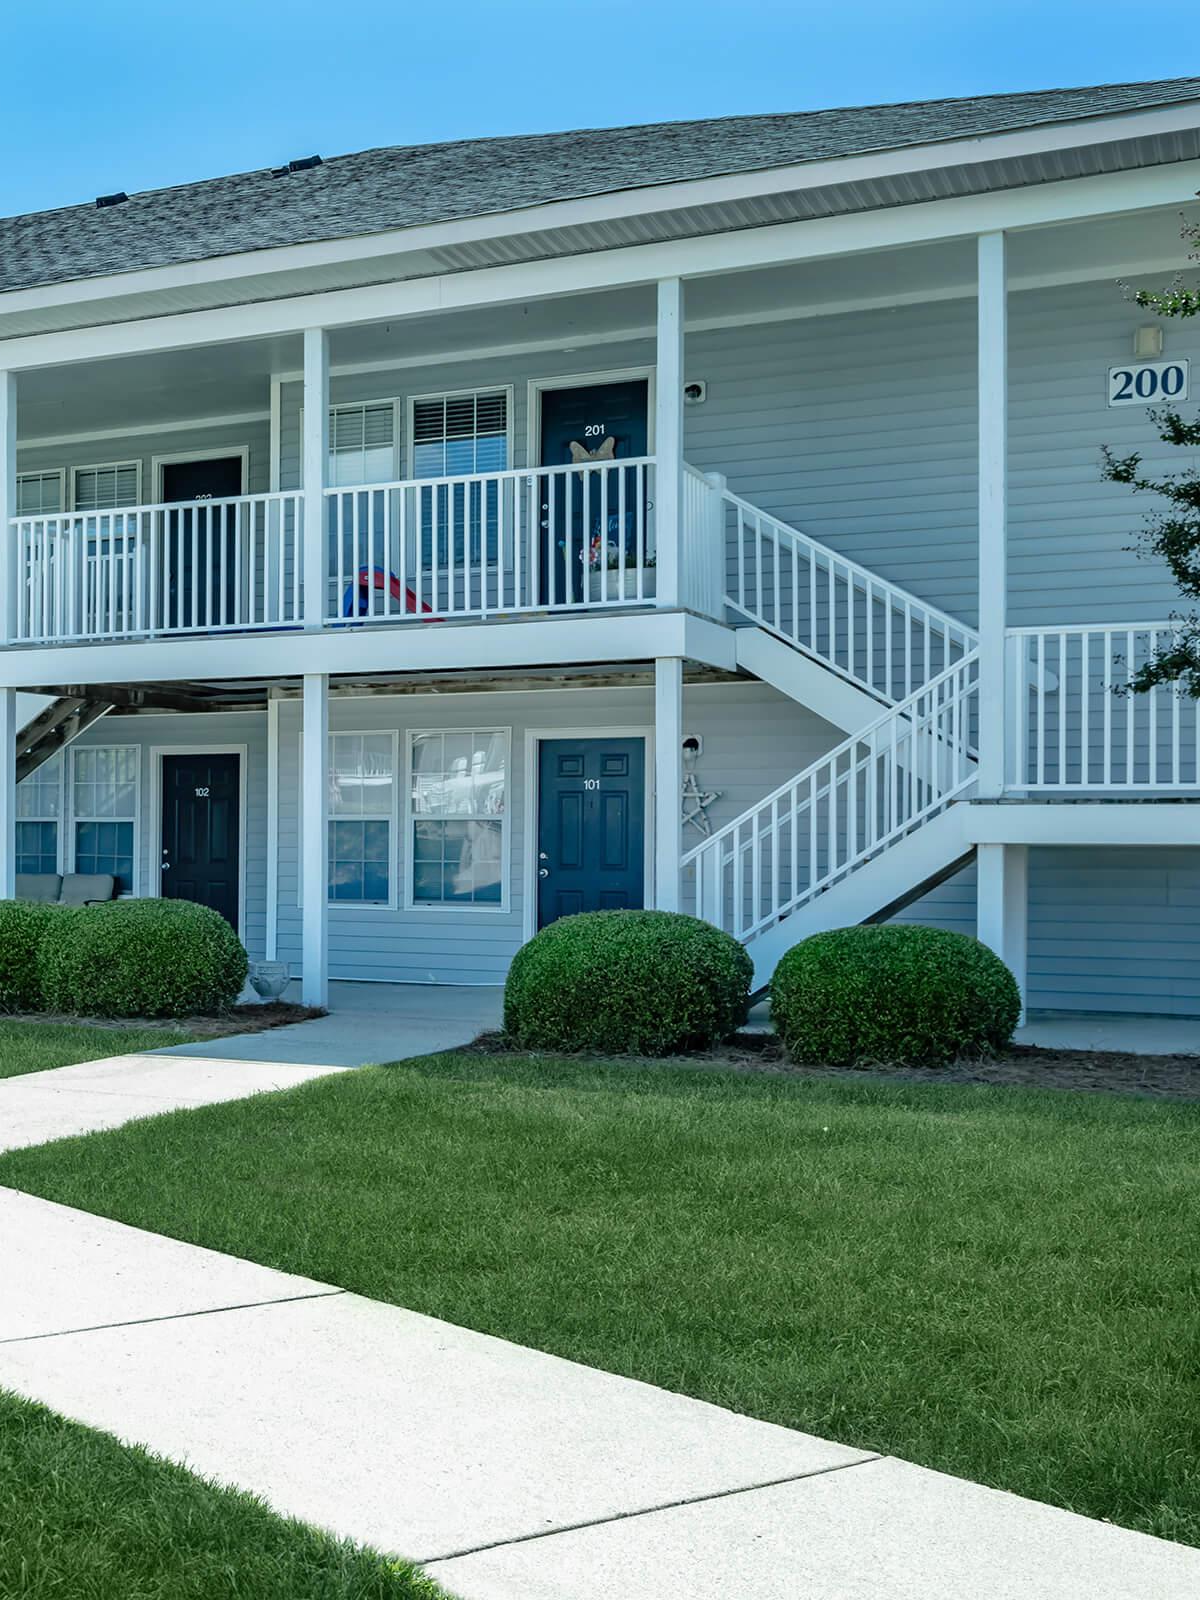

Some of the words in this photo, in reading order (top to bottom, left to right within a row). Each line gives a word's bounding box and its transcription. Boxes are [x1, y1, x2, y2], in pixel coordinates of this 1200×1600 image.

[1112, 366, 1184, 400] 200
[584, 423, 605, 437] 201
[583, 779, 600, 790] 101
[194, 787, 210, 797] 102
